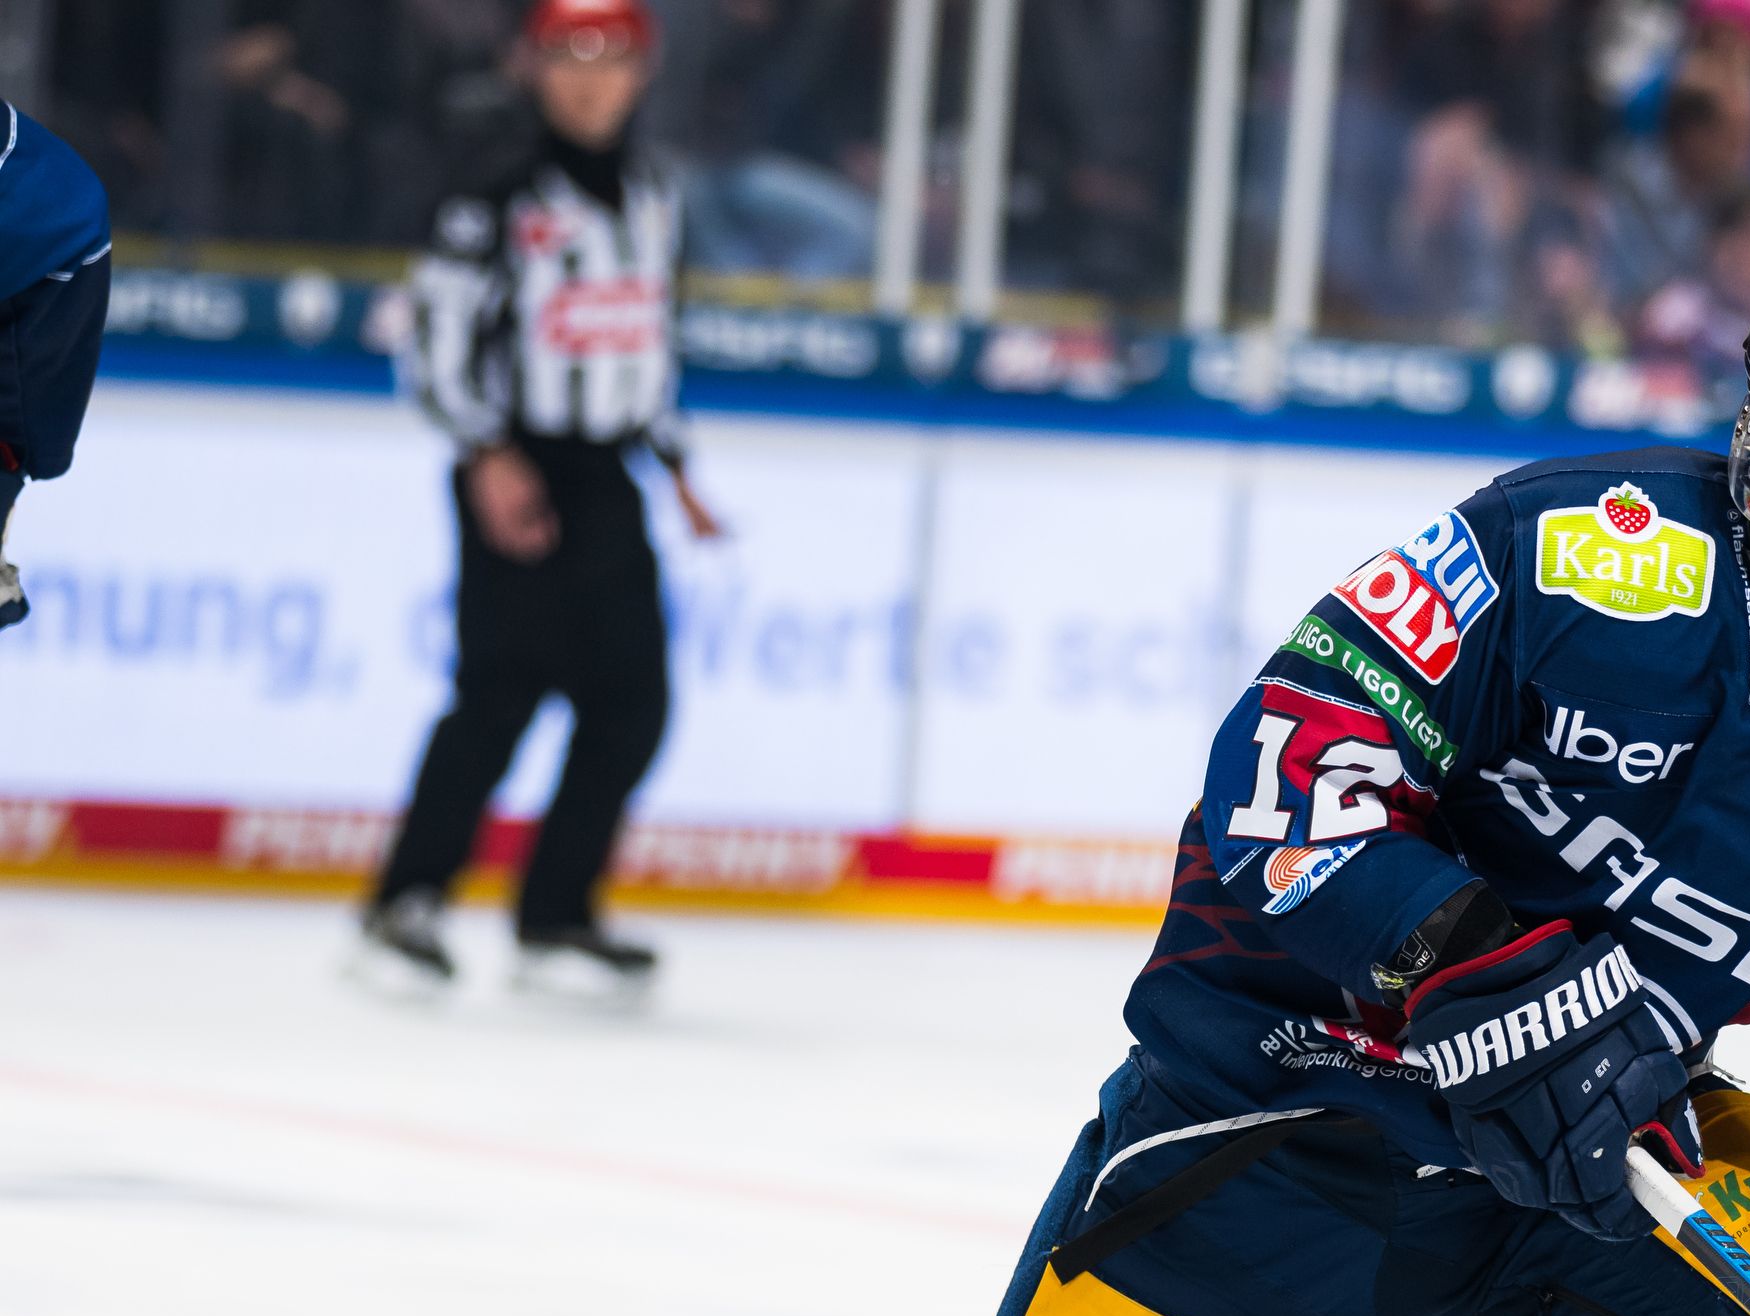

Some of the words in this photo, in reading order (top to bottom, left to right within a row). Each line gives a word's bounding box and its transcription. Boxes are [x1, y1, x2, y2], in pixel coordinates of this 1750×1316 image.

[1404, 514, 1487, 623] QUI
[1551, 530, 1699, 600] Karls
[1611, 588, 1638, 607] 1921
[1297, 622, 1334, 657] LIGO
[1342, 651, 1400, 705] LIGO
[1402, 700, 1442, 751] LIGO
[1227, 714, 1404, 841] 12
[1427, 944, 1643, 1090] WARRIOR
